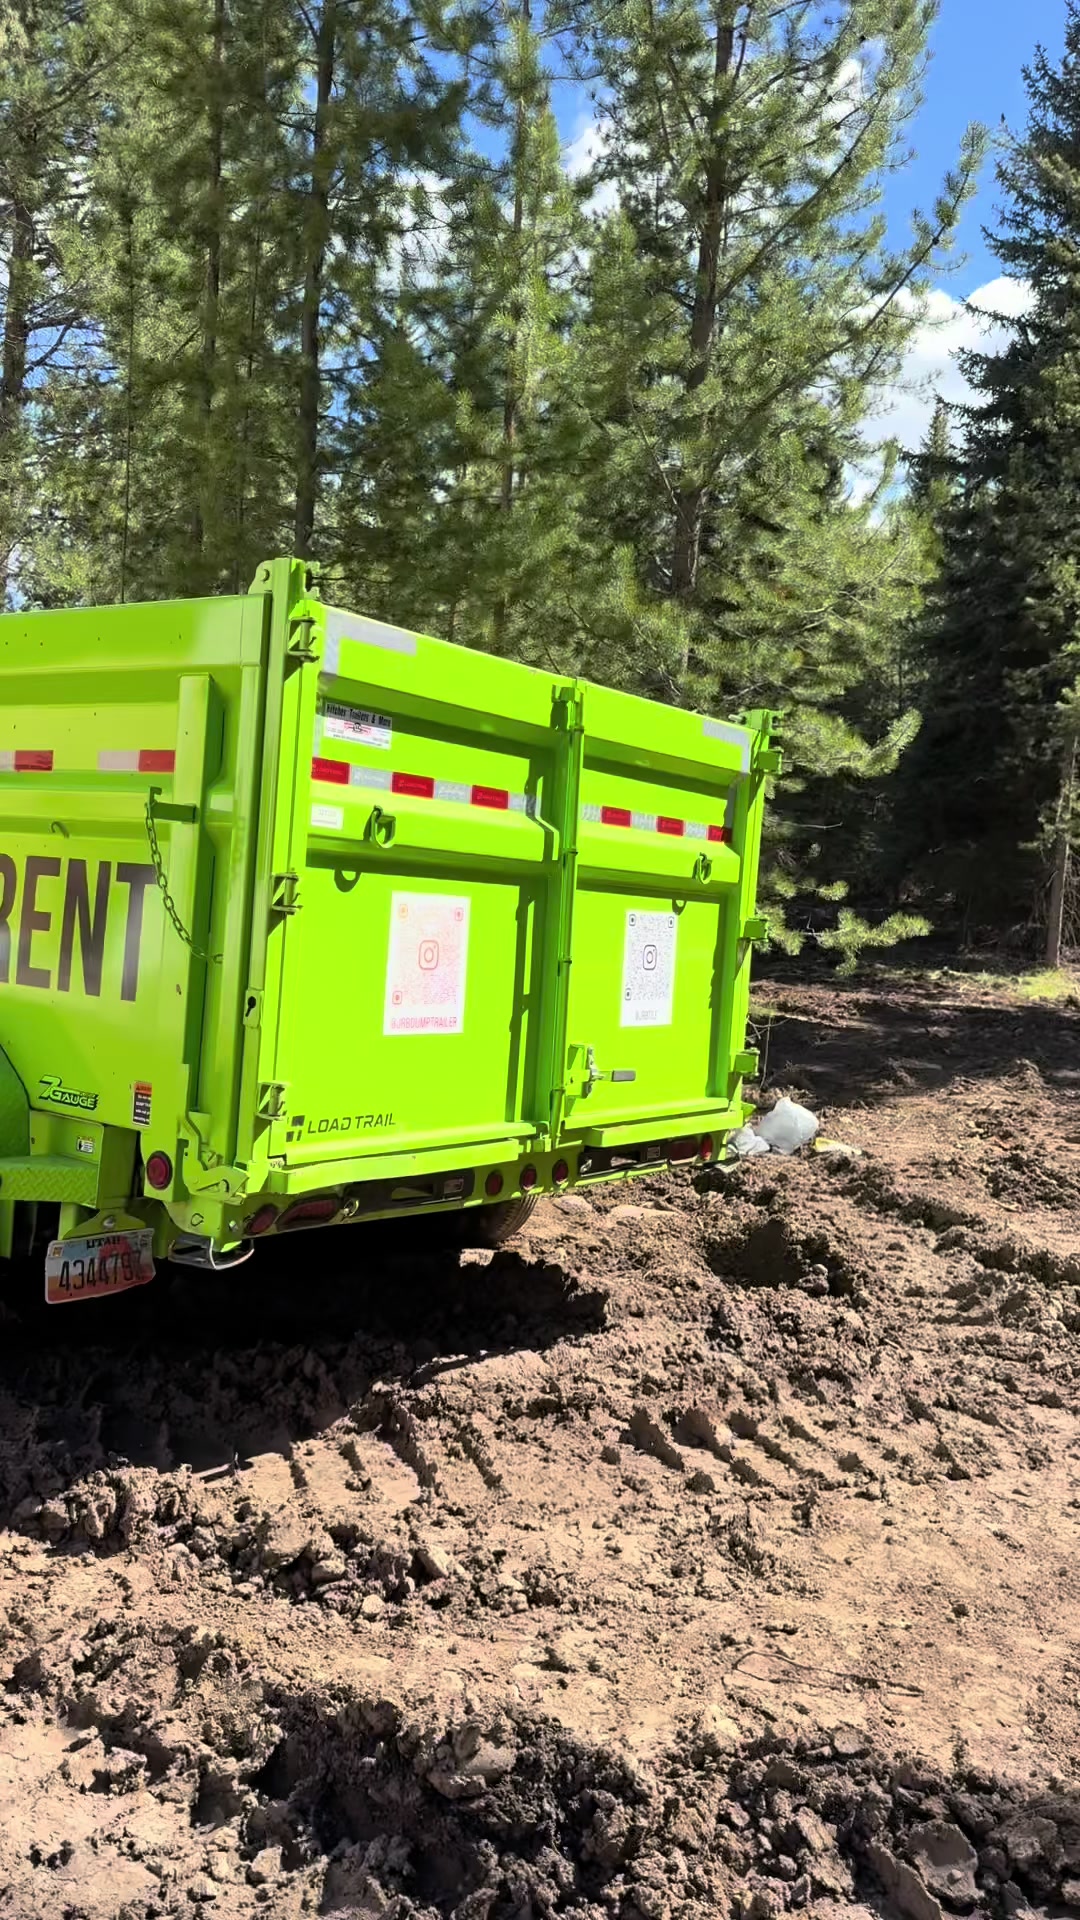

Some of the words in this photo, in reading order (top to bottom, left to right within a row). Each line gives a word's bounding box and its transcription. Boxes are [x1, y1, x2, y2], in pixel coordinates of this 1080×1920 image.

[371, 714, 376, 724] &
[39, 1074, 62, 1100] 7
[50, 1086, 98, 1110] GAUGE
[307, 1118, 352, 1134] LOAD
[355, 1113, 395, 1129] TRAIL
[86, 1236, 121, 1250] UTAH
